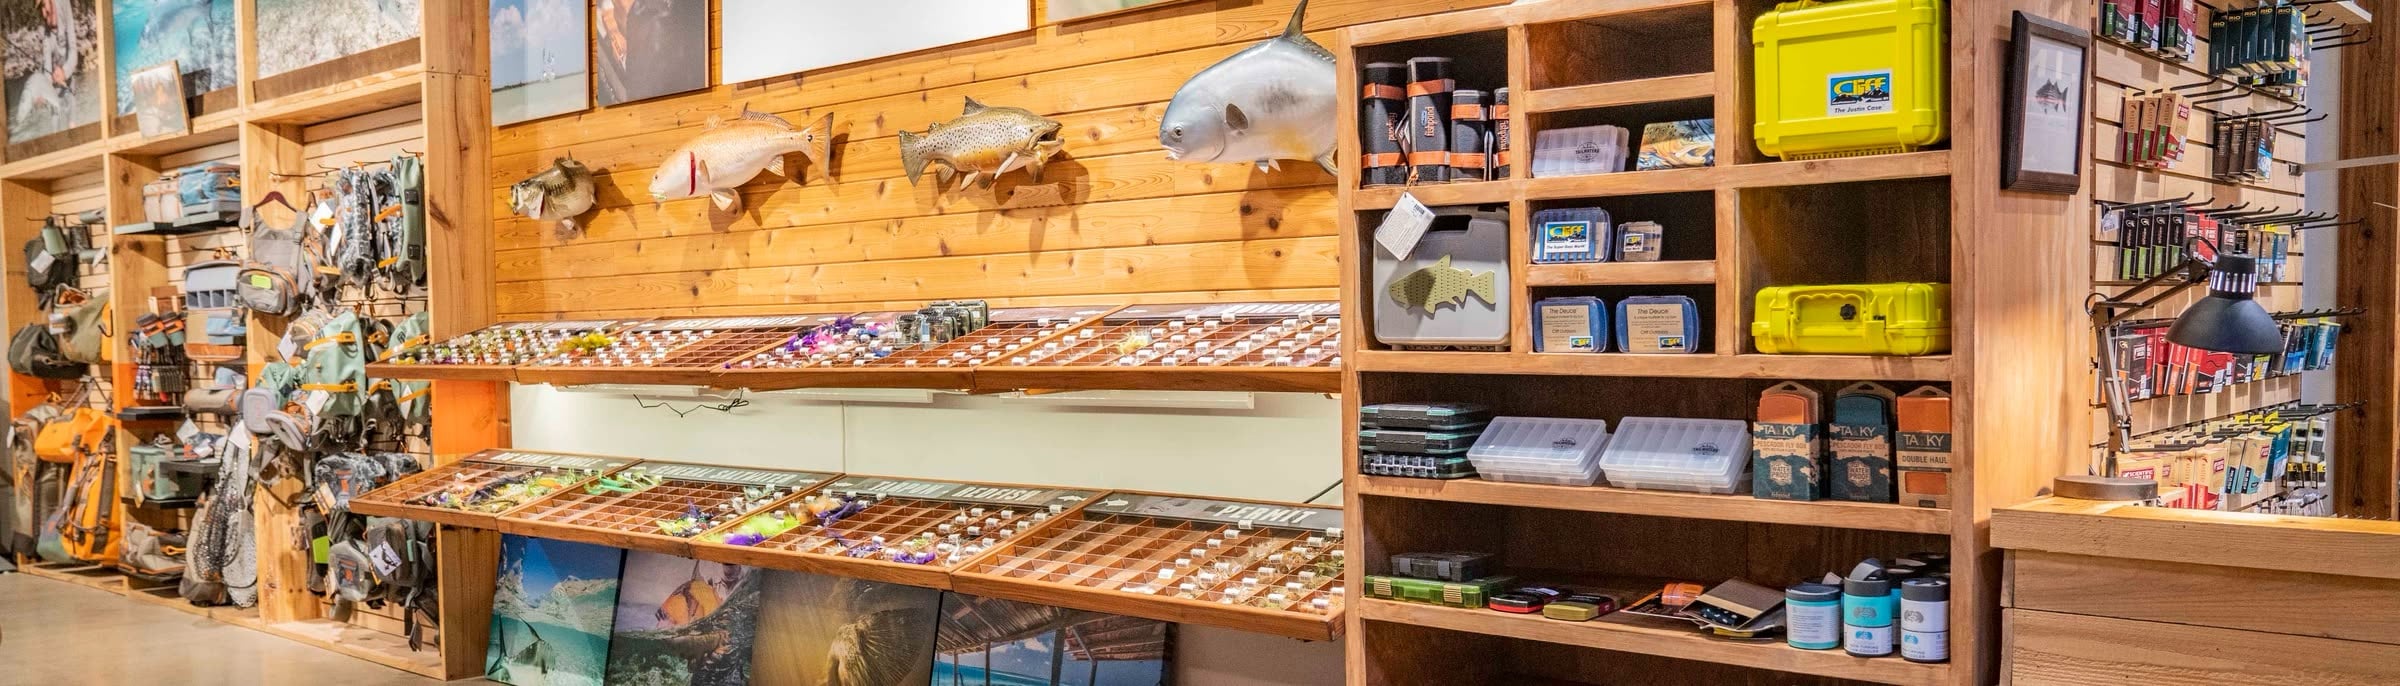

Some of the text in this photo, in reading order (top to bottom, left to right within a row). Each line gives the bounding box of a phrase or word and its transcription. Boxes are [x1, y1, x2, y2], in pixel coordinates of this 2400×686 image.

[1424, 106, 1437, 137] fishpond
[1763, 424, 1797, 436] TAKY
[1840, 425, 1876, 437] TAKY
[1903, 433, 1945, 447] TAKY
[1902, 455, 1948, 464] DOUBLE HAUL
[709, 469, 799, 484] SALTWATER
[868, 481, 1043, 501] TARPON REDFISH
[1213, 504, 1317, 524] PERMIT
